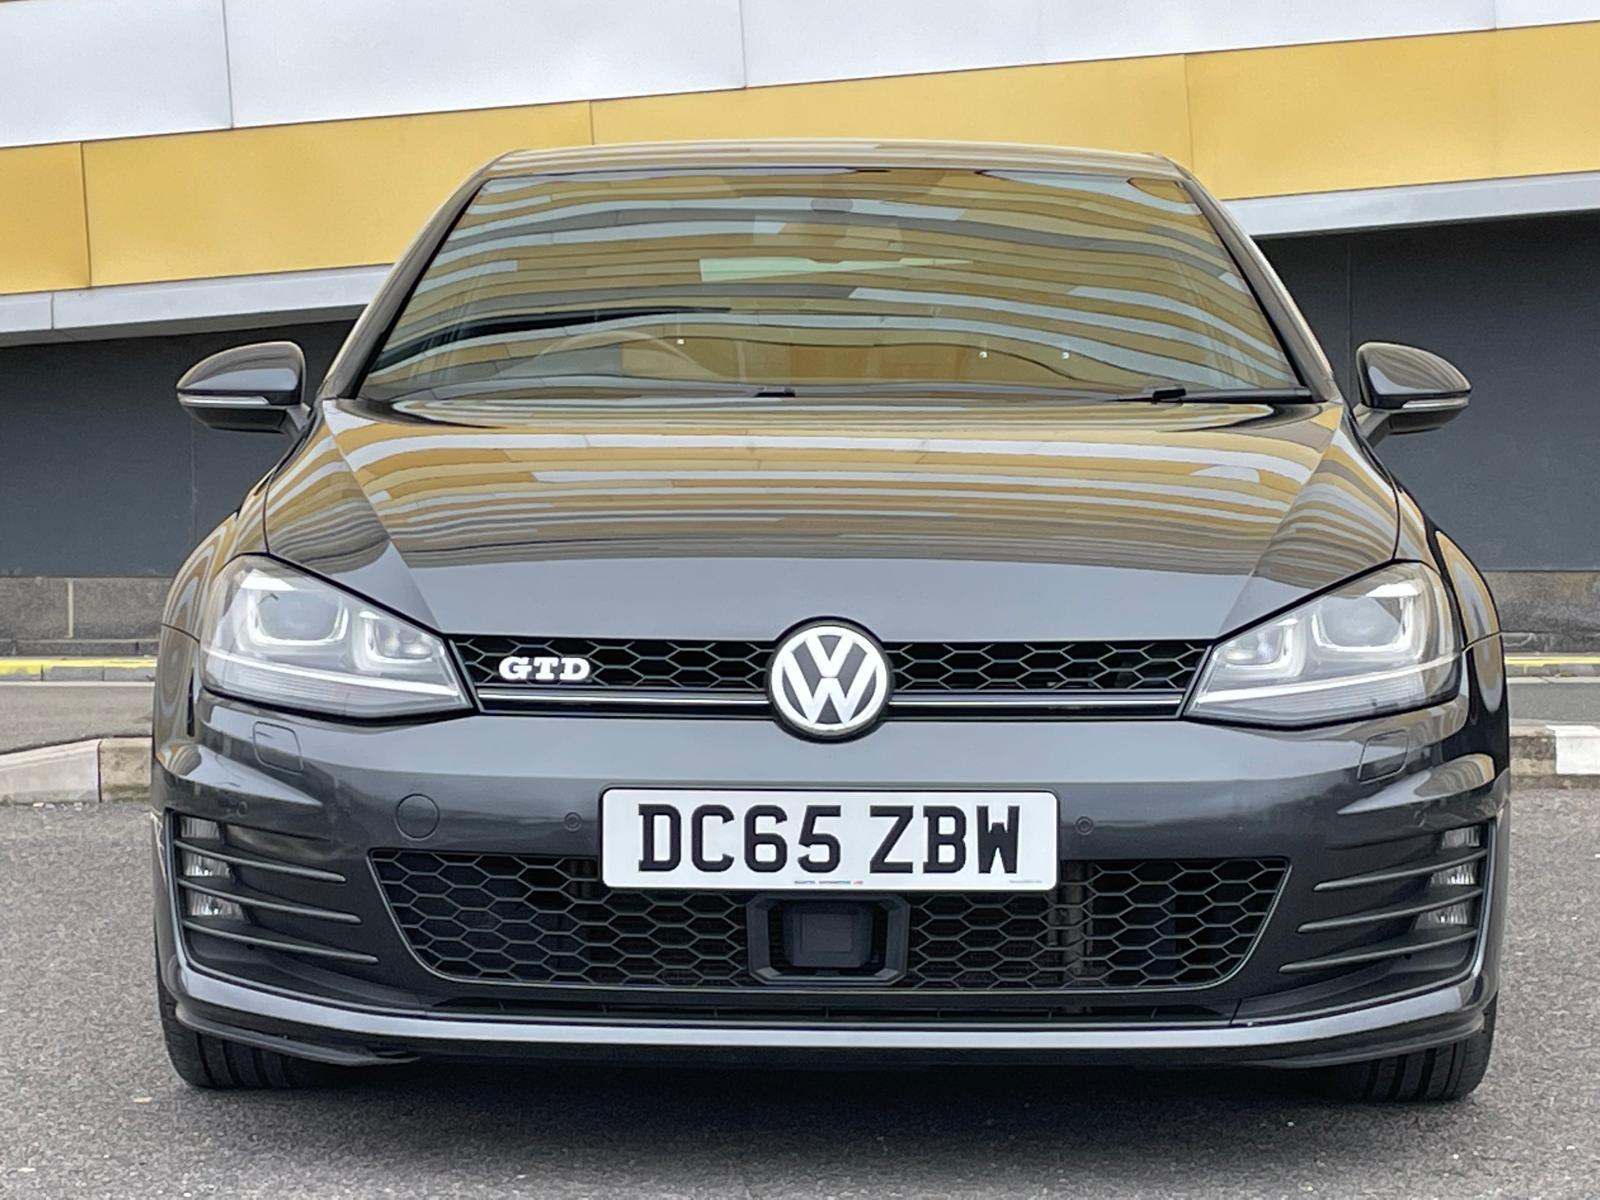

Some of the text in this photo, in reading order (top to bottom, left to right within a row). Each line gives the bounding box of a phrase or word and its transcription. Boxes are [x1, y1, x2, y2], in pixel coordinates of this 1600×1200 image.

[498, 656, 591, 682] GTD
[772, 627, 888, 731] VW
[638, 803, 1021, 874] DC65 ZBW
